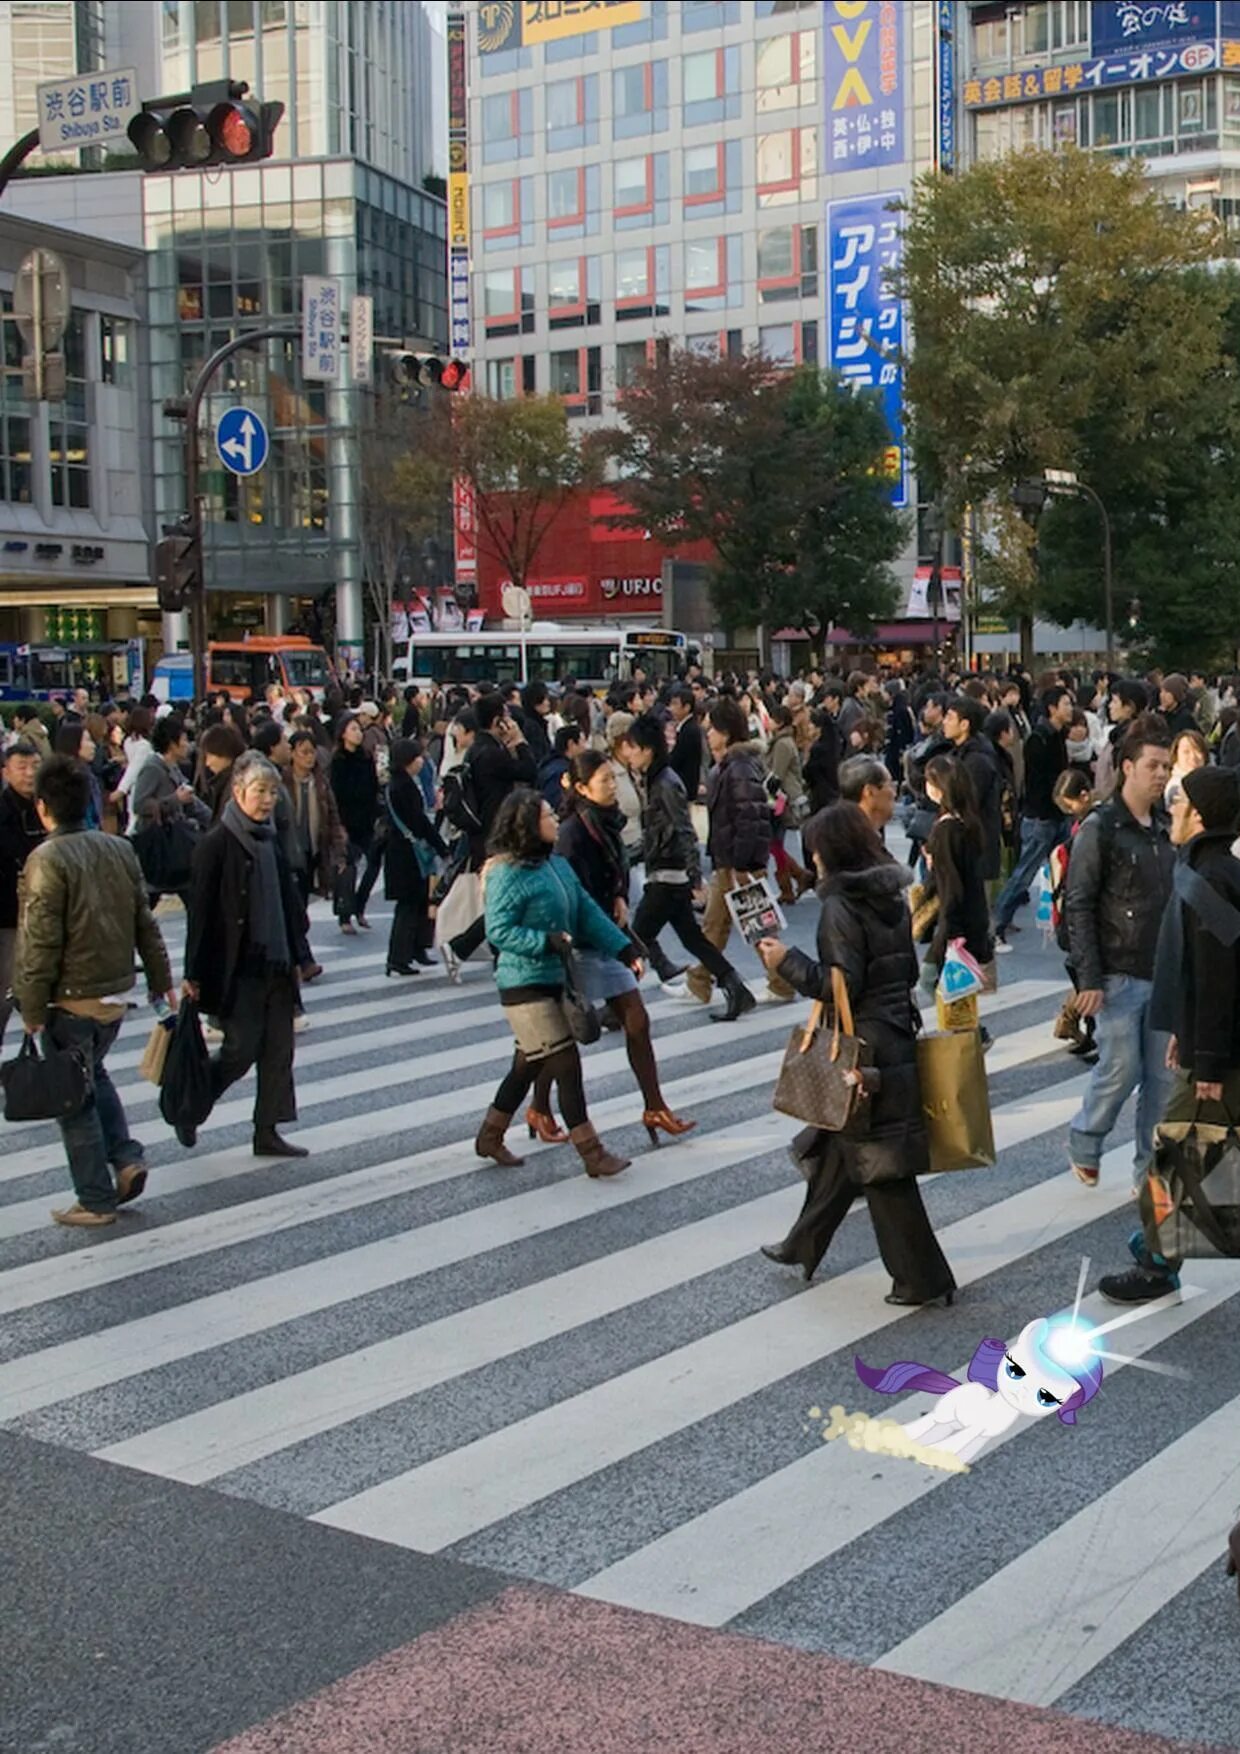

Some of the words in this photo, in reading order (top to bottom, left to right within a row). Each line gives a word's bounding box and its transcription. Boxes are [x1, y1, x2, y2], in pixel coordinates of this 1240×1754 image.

[1185, 47, 1211, 67] 6F
[44, 77, 132, 121] 渋谷駅前
[60, 121, 100, 141] Shibuya
[319, 286, 336, 373] 渋谷駅前
